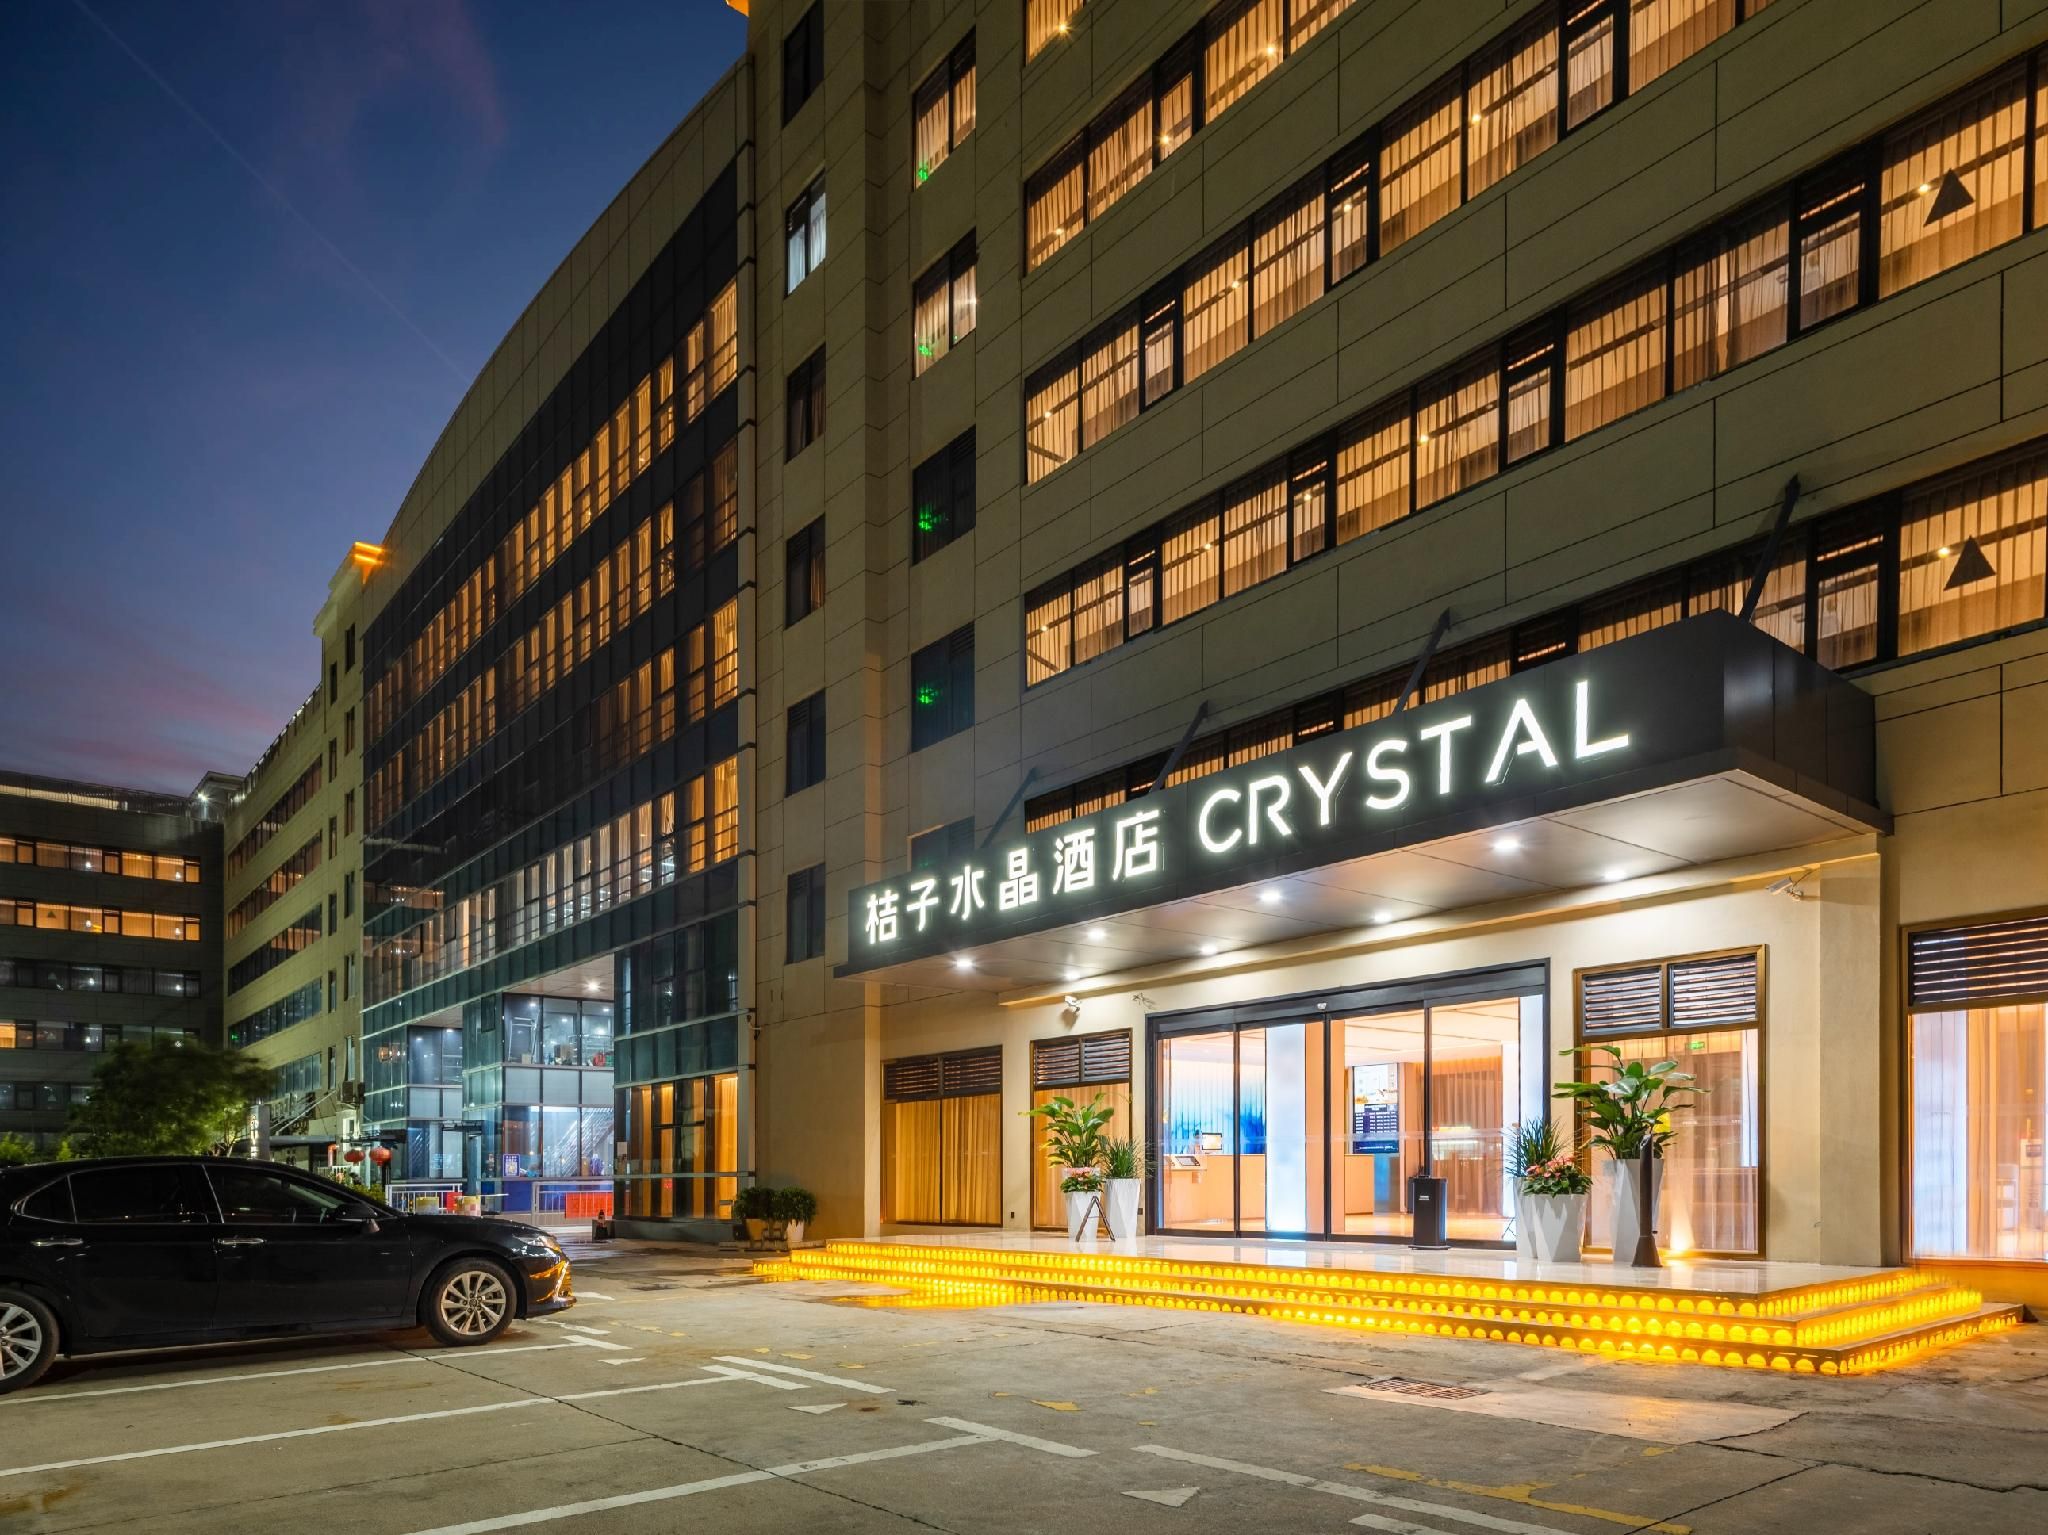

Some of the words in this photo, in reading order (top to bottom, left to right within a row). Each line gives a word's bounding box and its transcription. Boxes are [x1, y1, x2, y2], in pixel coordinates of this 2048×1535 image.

[865, 809, 1160, 945] 桔子水晶酒店
[1198, 680, 1630, 854] CRYSTAL
